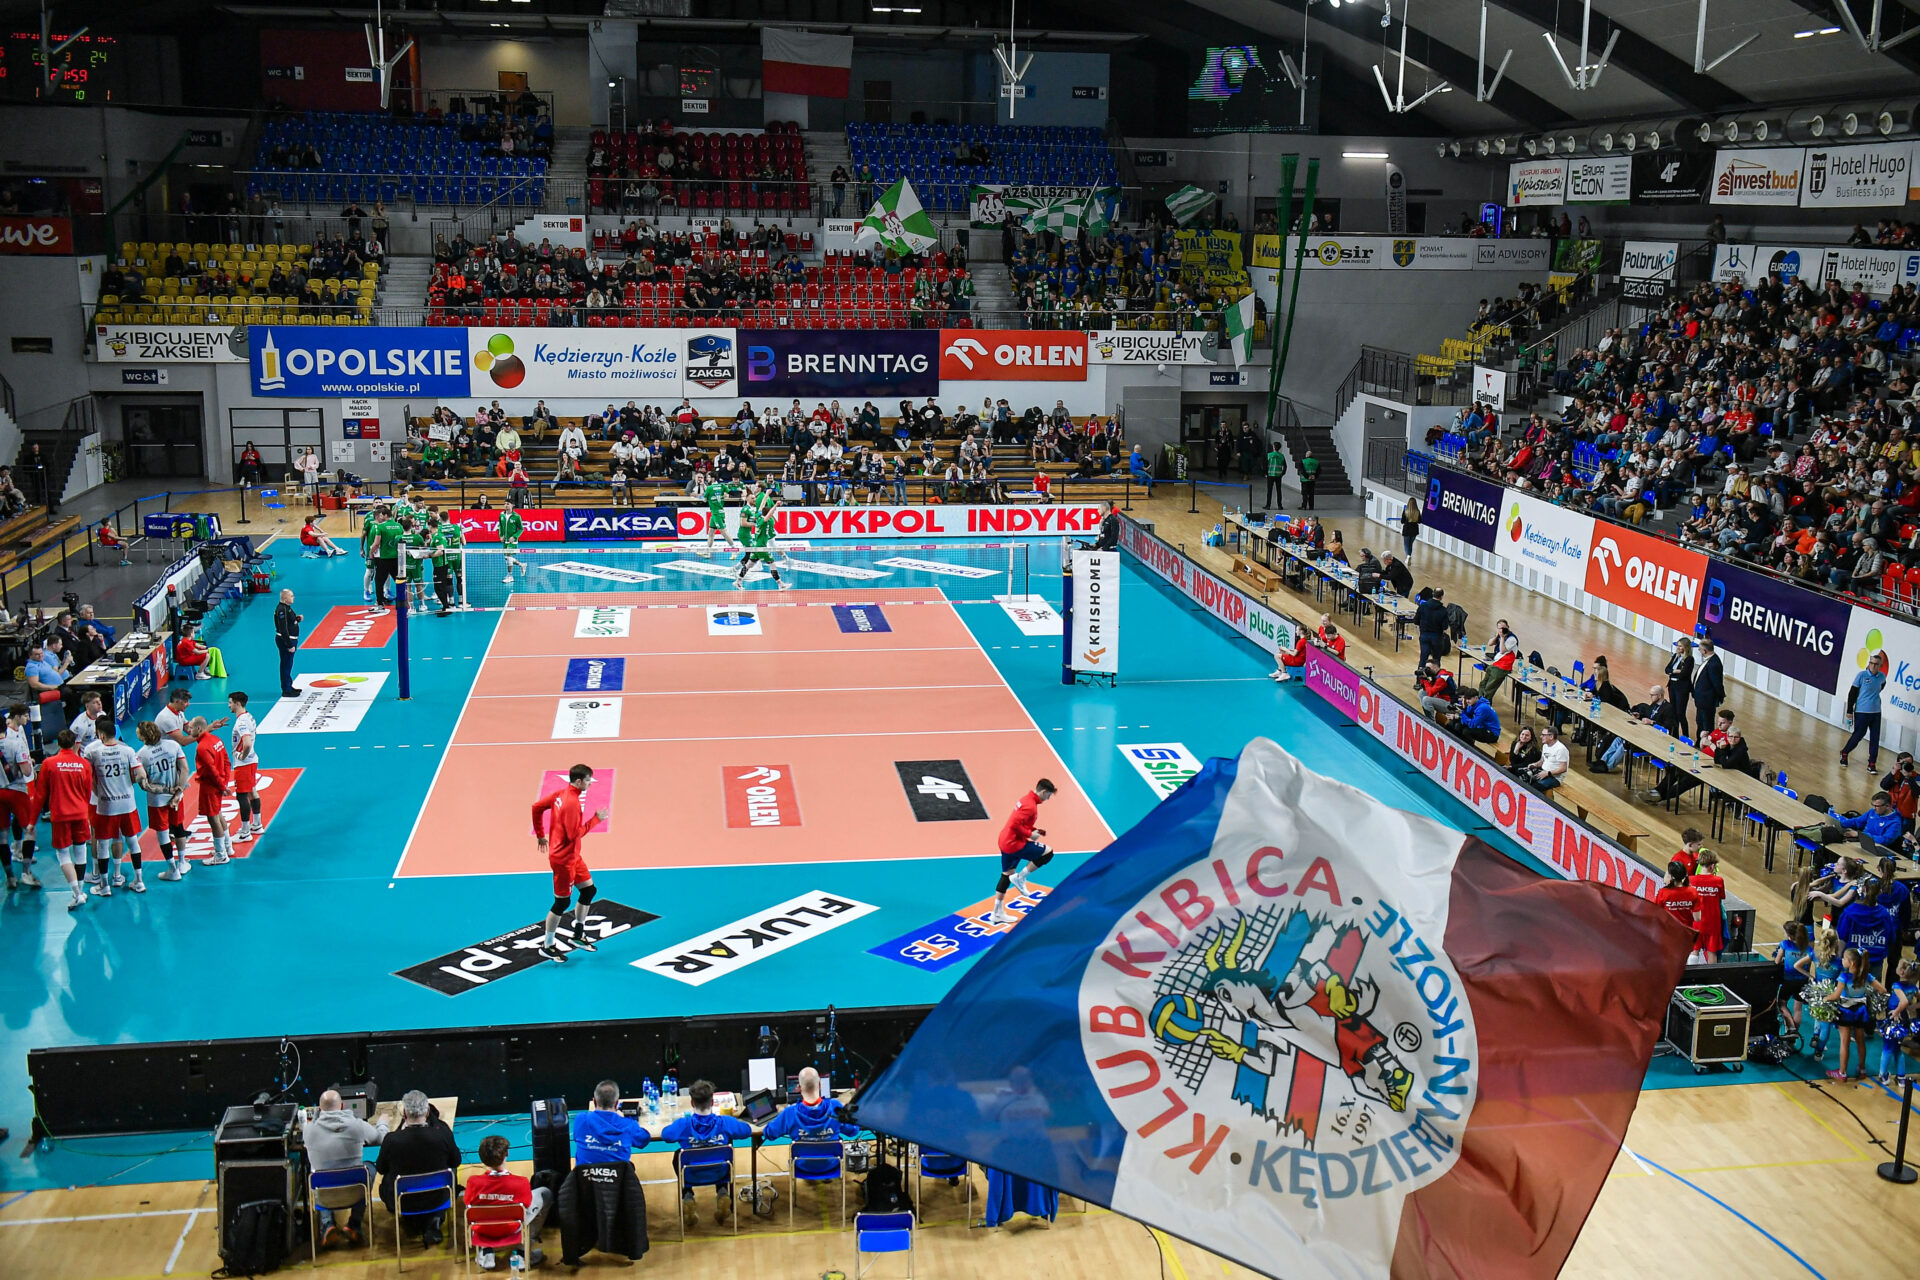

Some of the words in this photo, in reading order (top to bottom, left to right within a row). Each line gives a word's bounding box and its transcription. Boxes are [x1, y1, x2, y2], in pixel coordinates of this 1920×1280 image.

[90, 50, 107, 63] 24
[190, 134, 208, 143] WC
[1582, 165, 1606, 176] GRUPA
[1660, 162, 1681, 182] 4F
[1831, 154, 1866, 175] Hotel
[1869, 154, 1905, 178] Hugo
[1728, 165, 1798, 195] Investbud
[1002, 187, 1029, 199] AZS
[1836, 186, 1871, 198] Business
[1879, 186, 1895, 198] Spa
[543, 221, 568, 229] SEKTOR
[694, 219, 719, 227] SEKTOR
[828, 224, 853, 232] SEKTOR
[1185, 238, 1202, 250] TAL
[1206, 238, 1234, 251] NYSA
[1480, 250, 1496, 259] KM
[1498, 250, 1547, 260] ADVISORY
[1624, 251, 1666, 270] Polbruk
[1770, 262, 1798, 273] EURO-DK
[1841, 256, 1868, 271] Hotel
[1870, 257, 1896, 276] Hugo
[115, 332, 231, 345] KIBICUJEMY
[1105, 336, 1203, 349] KIBICUJEMY
[140, 346, 214, 358] ZAKSIE!
[994, 345, 1083, 367] ORLEN
[1124, 349, 1187, 361] ZAKSIE!
[286, 348, 463, 376] OPOLSKIE
[788, 354, 929, 374] BRENNTAG
[126, 372, 142, 381] WC
[567, 369, 607, 379] Miasto
[611, 369, 677, 379] możliwości
[689, 369, 732, 378] ZAKSA
[1213, 375, 1227, 383] WC
[322, 383, 420, 394] www.opolskie.pl
[1476, 390, 1500, 405] Galmet
[1442, 490, 1496, 526] BRENNTAG
[484, 521, 558, 532] TARON
[570, 516, 675, 531] ZAKSA
[772, 510, 945, 534] NDYKPOL
[1132, 527, 1187, 589] INDYKPOL
[1192, 569, 1247, 625] INDYKP
[1625, 556, 1699, 611] ORLEN
[1089, 558, 1101, 646] KRISHOME
[329, 619, 376, 647] ORLEN
[1250, 612, 1274, 640] plus
[1730, 597, 1834, 656] BRENNTAG
[1321, 668, 1356, 706] TAURON
[1889, 695, 1916, 713] Miasto
[104, 763, 121, 778] 23
[155, 758, 170, 773] 10
[916, 775, 971, 802] 4F
[746, 786, 781, 826] ORLEN
[1396, 710, 1533, 843] INDYKPOL
[1552, 816, 1658, 904] INDY
[1101, 846, 1342, 979] KIBICA
[655, 897, 856, 974] FLUKAR
[900, 934, 959, 963] STS
[1248, 900, 1472, 1209] KĘDZIERZYN-KOŹLE
[1090, 1005, 1230, 1175] KLUB
[1350, 1102, 1376, 1146] 1997
[586, 1134, 622, 1146] ZAA
[689, 1133, 724, 1143] ZASA
[798, 1128, 834, 1137] ZASA
[582, 1167, 618, 1177] ZAKSA
